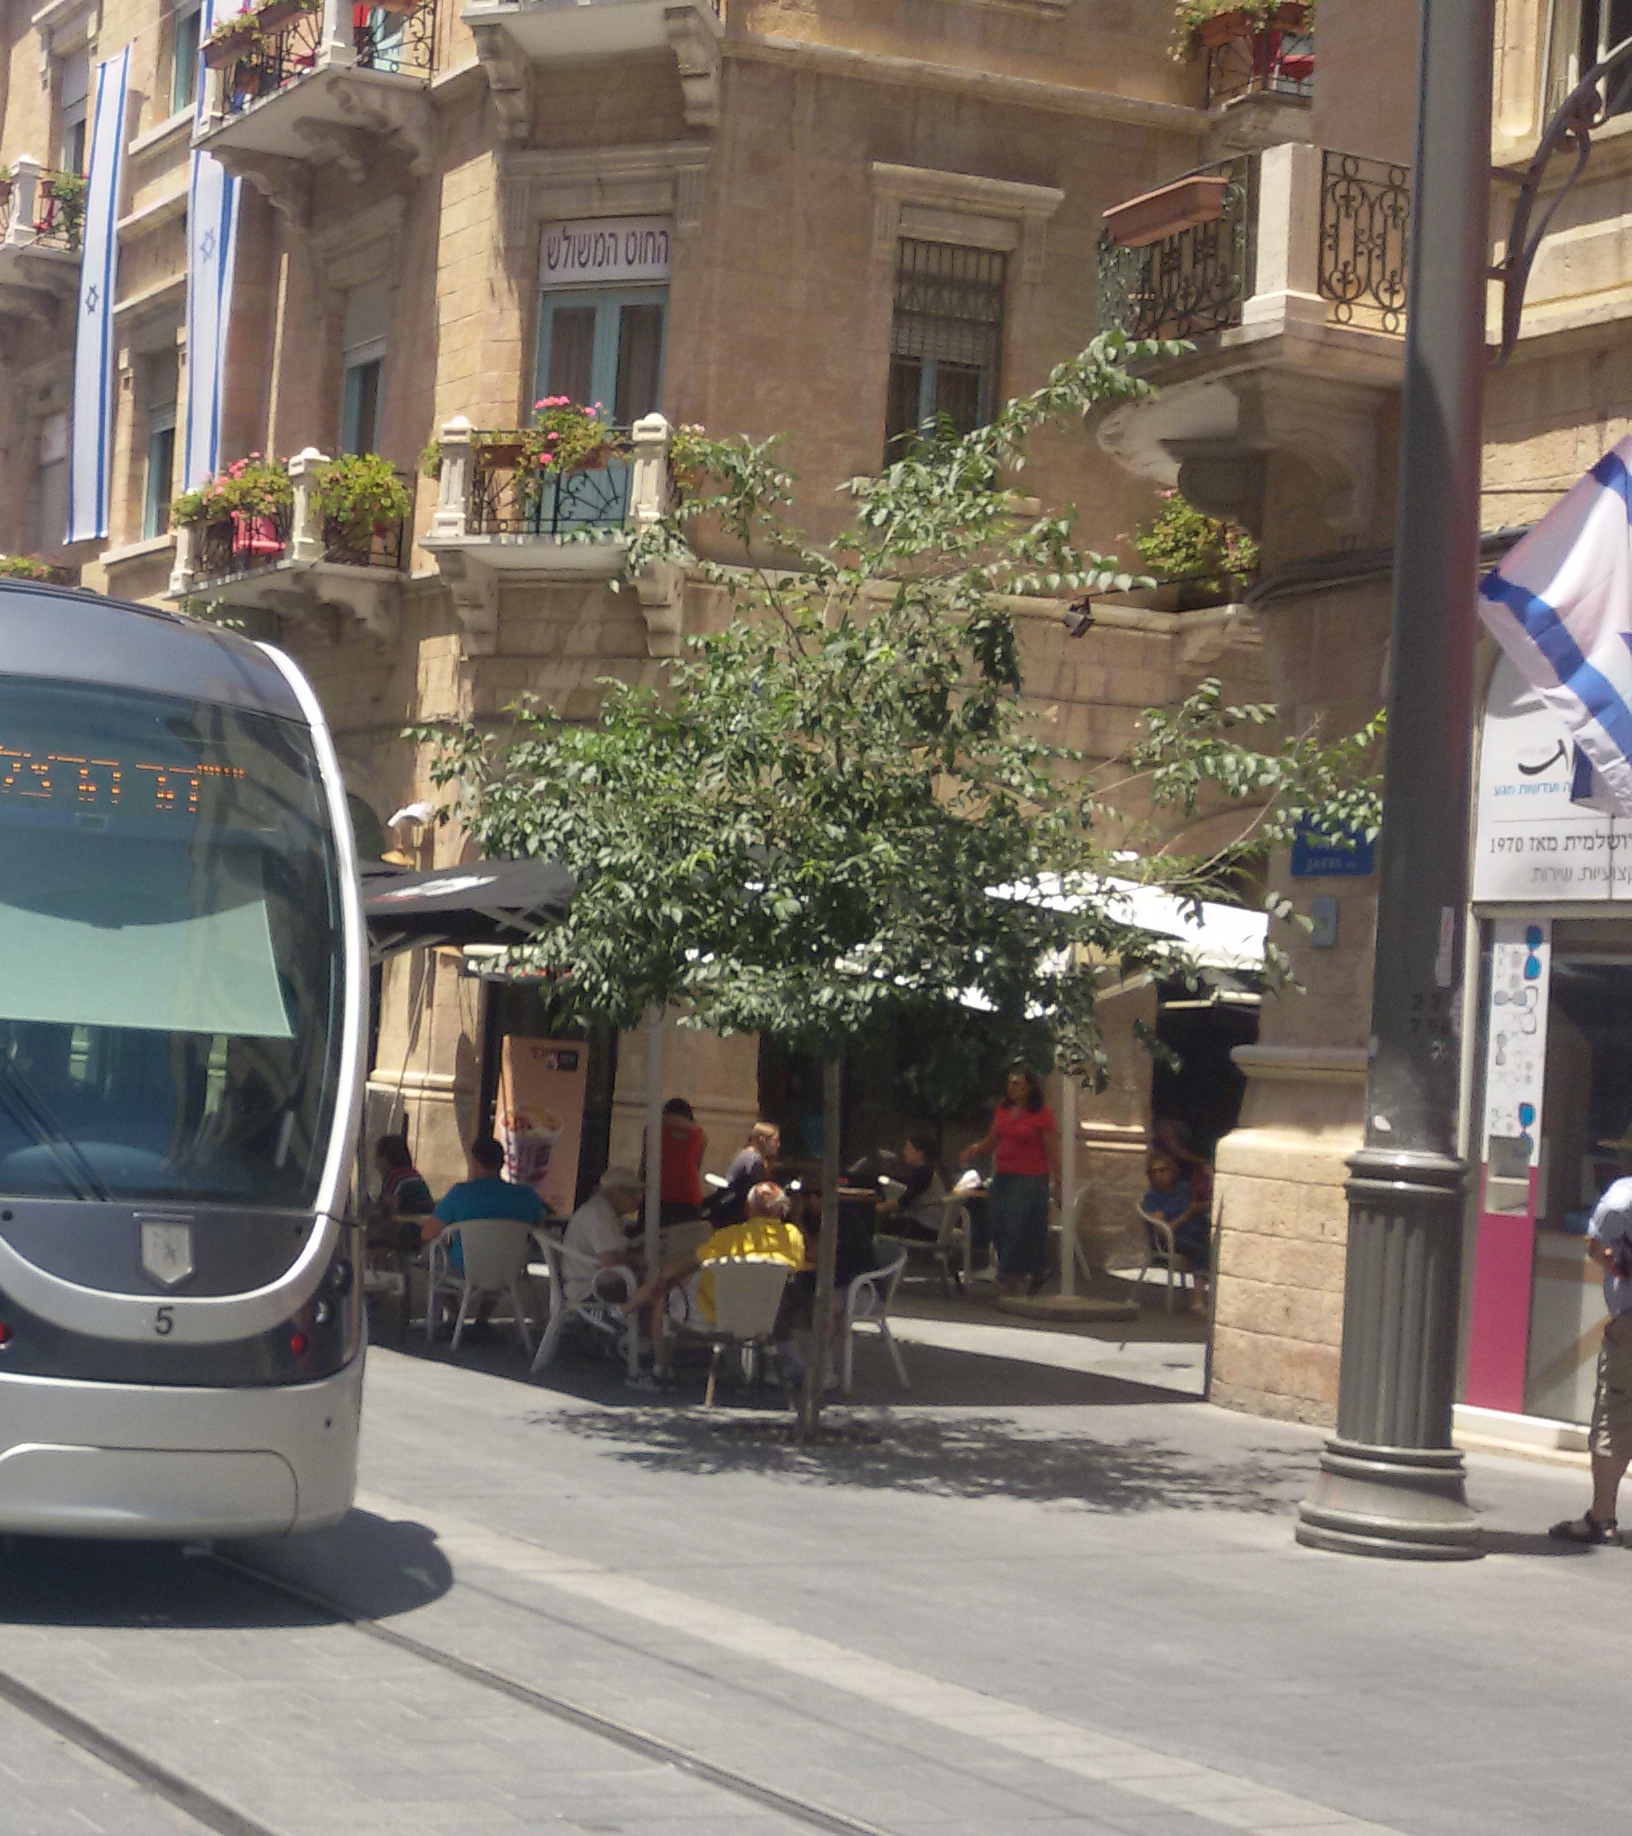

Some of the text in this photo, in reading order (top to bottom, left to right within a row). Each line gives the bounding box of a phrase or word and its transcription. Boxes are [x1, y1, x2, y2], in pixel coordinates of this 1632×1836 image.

[547, 226, 669, 271] החוט המשולש
[1489, 836, 1525, 854] 1970
[1528, 836, 1559, 852] מאז
[154, 1305, 175, 1335] 5
